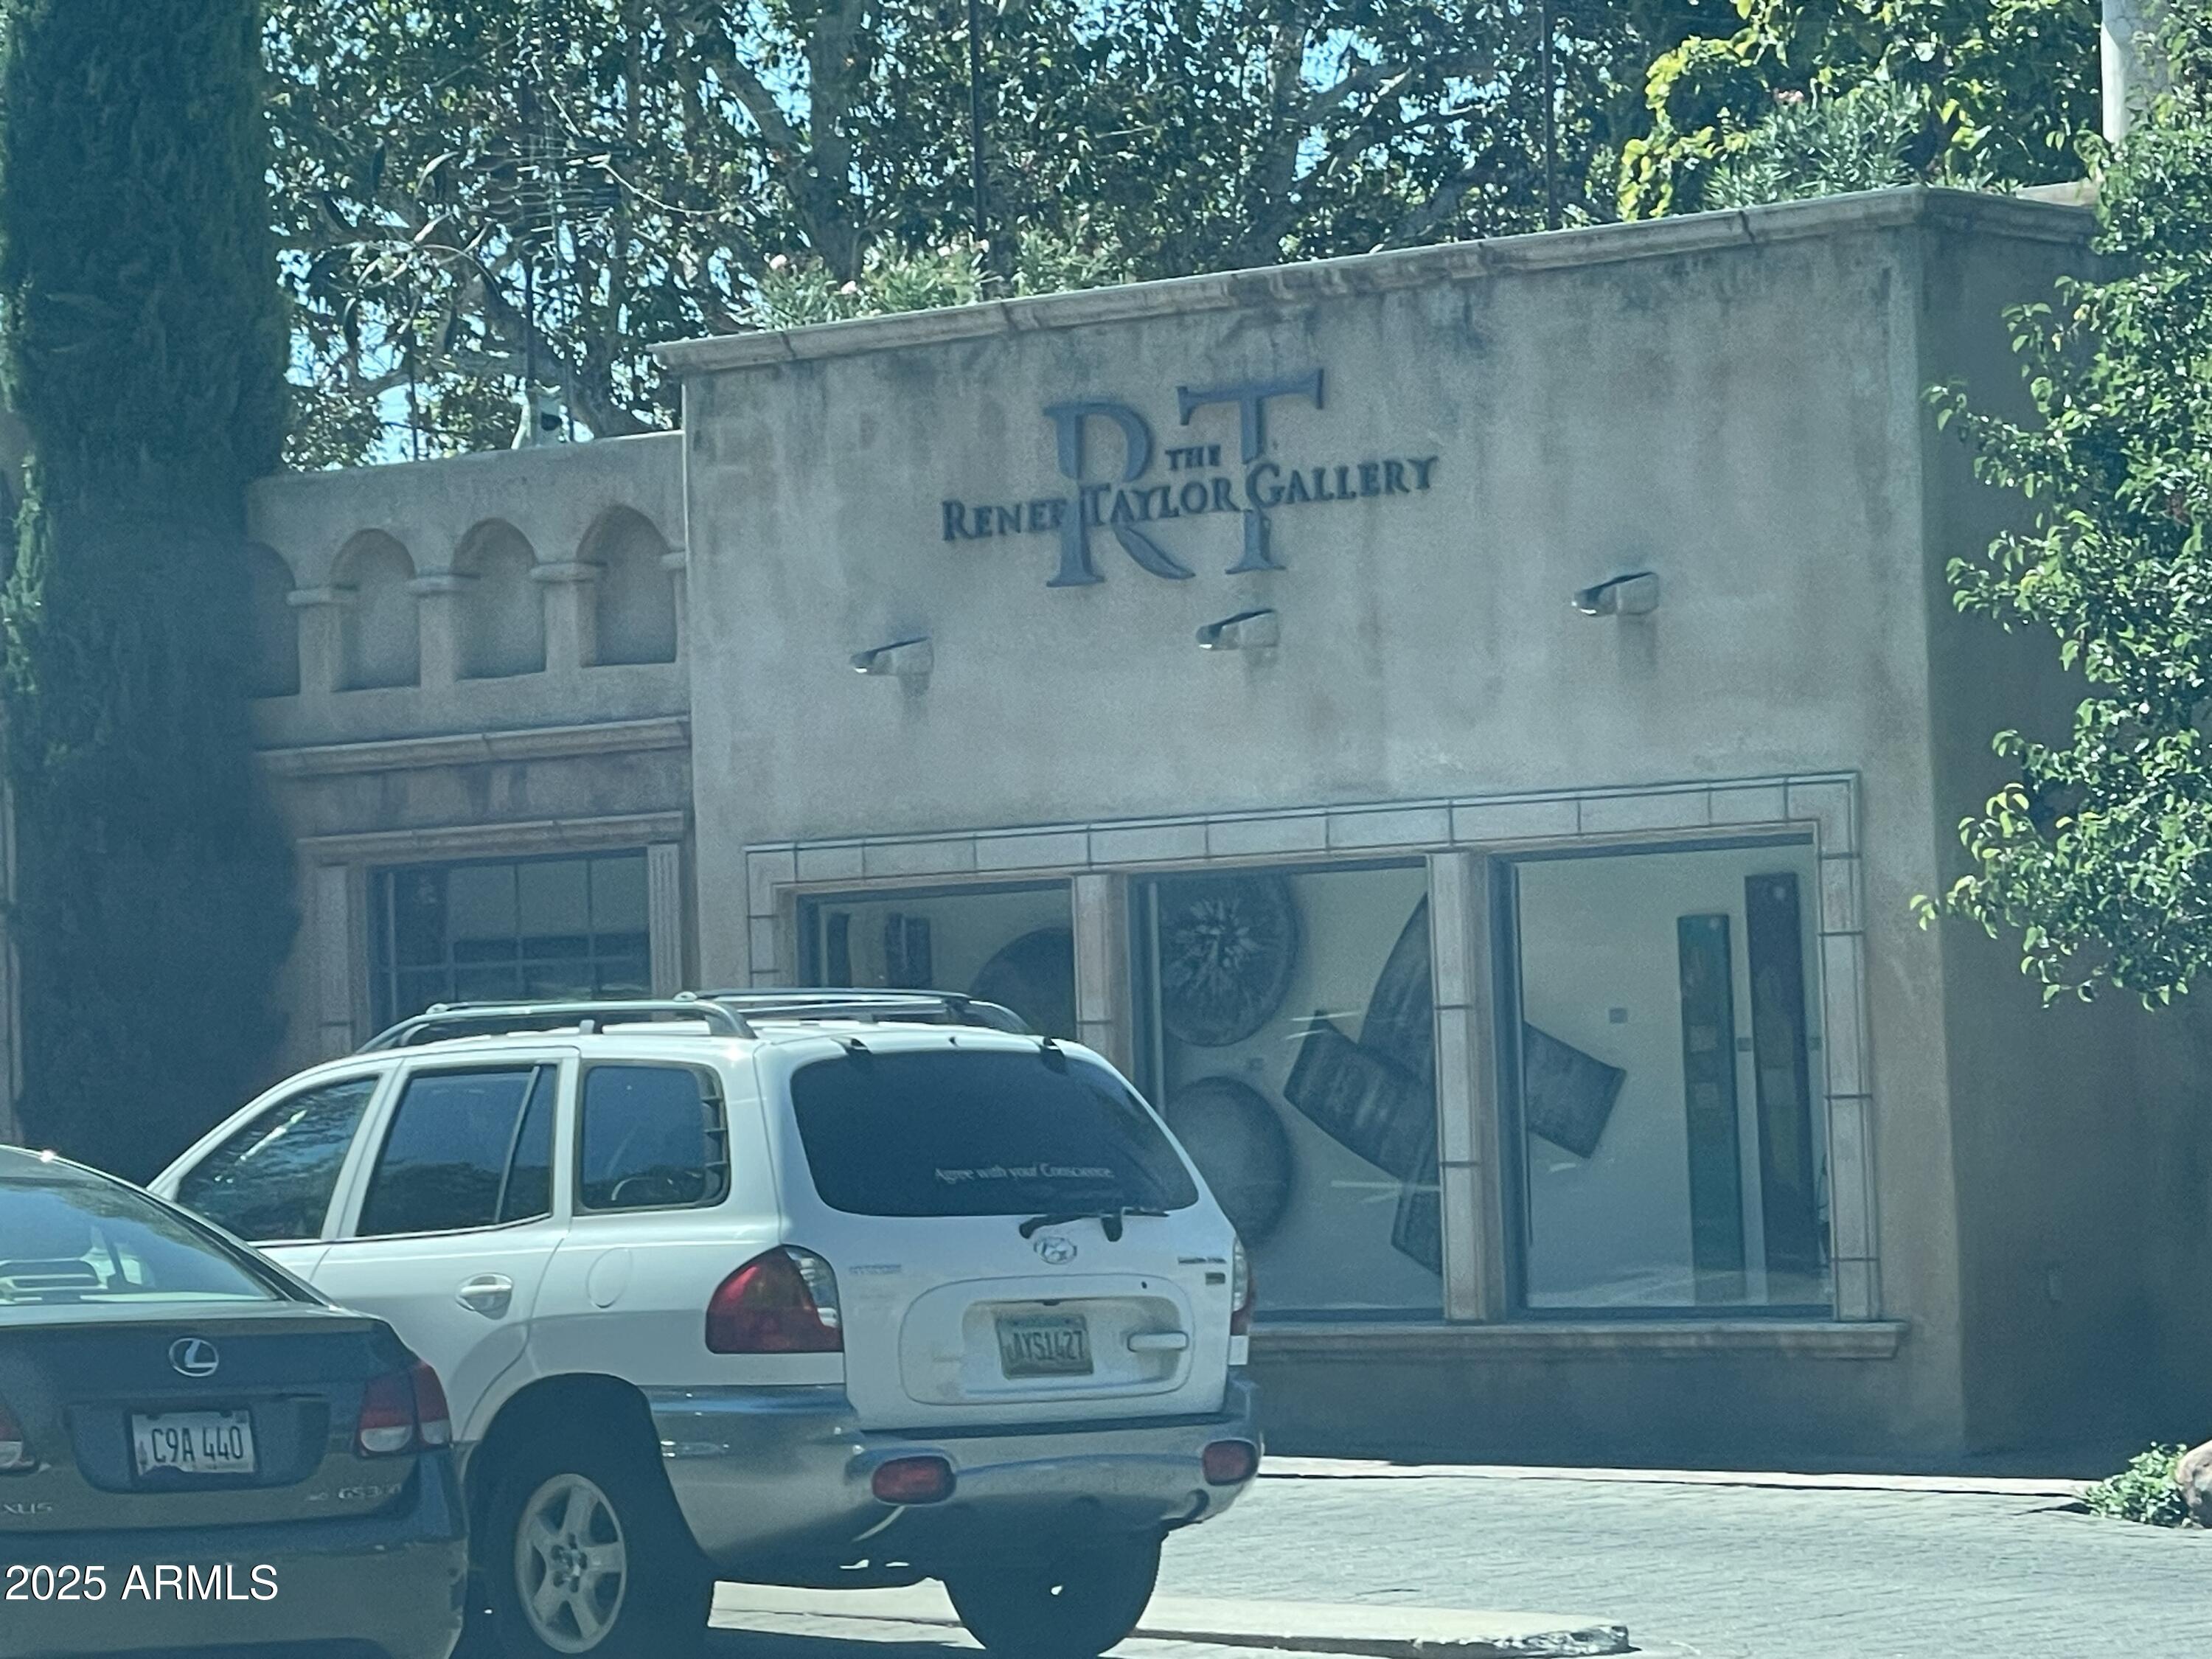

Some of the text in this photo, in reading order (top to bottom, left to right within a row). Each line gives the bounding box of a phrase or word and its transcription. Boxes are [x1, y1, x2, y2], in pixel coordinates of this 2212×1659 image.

[1164, 445, 1221, 472] THE
[1079, 476, 1253, 527] TAYLOR
[1245, 456, 1439, 510] GALLERY
[151, 1425, 244, 1463] C9A 440
